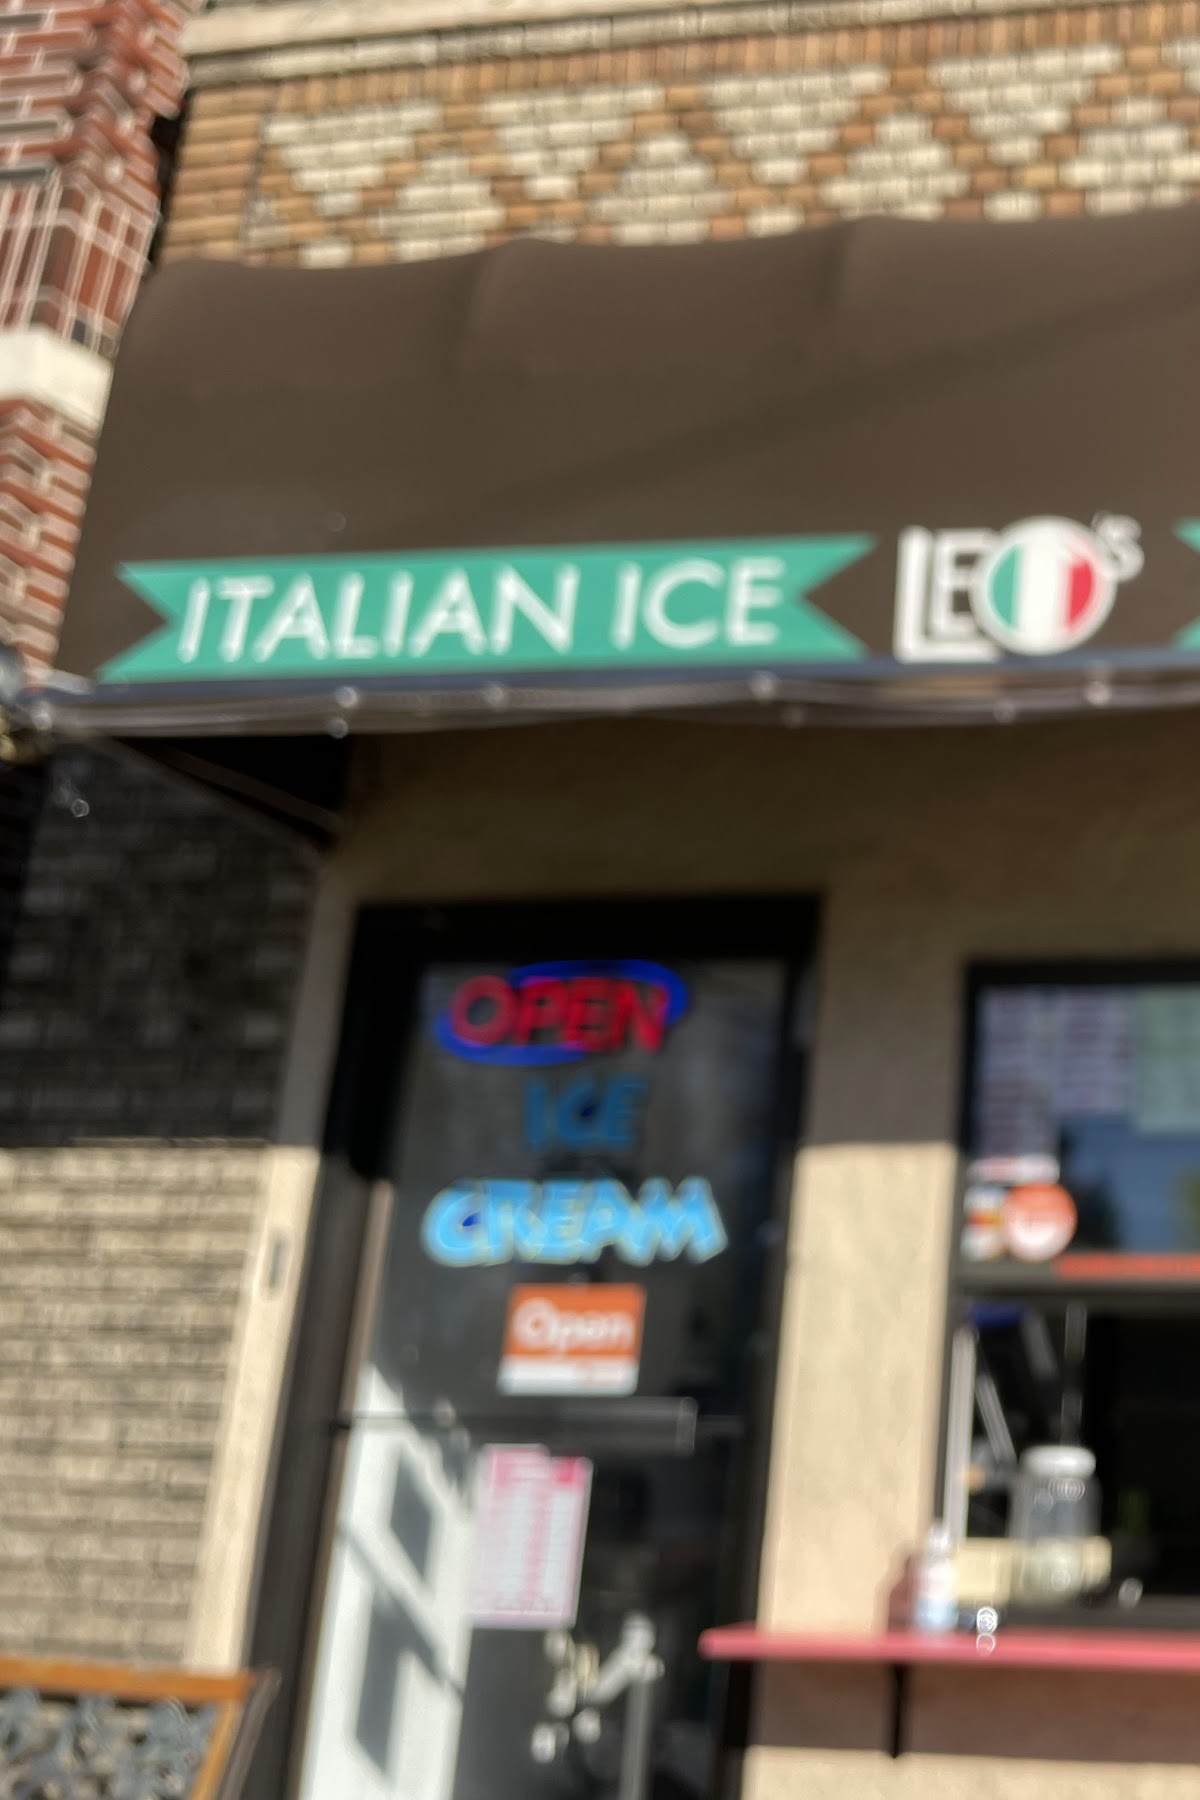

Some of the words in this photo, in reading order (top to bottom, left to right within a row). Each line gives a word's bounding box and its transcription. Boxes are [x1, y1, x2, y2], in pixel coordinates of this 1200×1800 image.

[177, 569, 578, 662] ITALIAN
[612, 555, 787, 649] ICE
[449, 974, 668, 1052] OPEN
[523, 1073, 648, 1150] ICE
[421, 1176, 728, 1266] CREAM
[513, 1297, 635, 1356] Open
